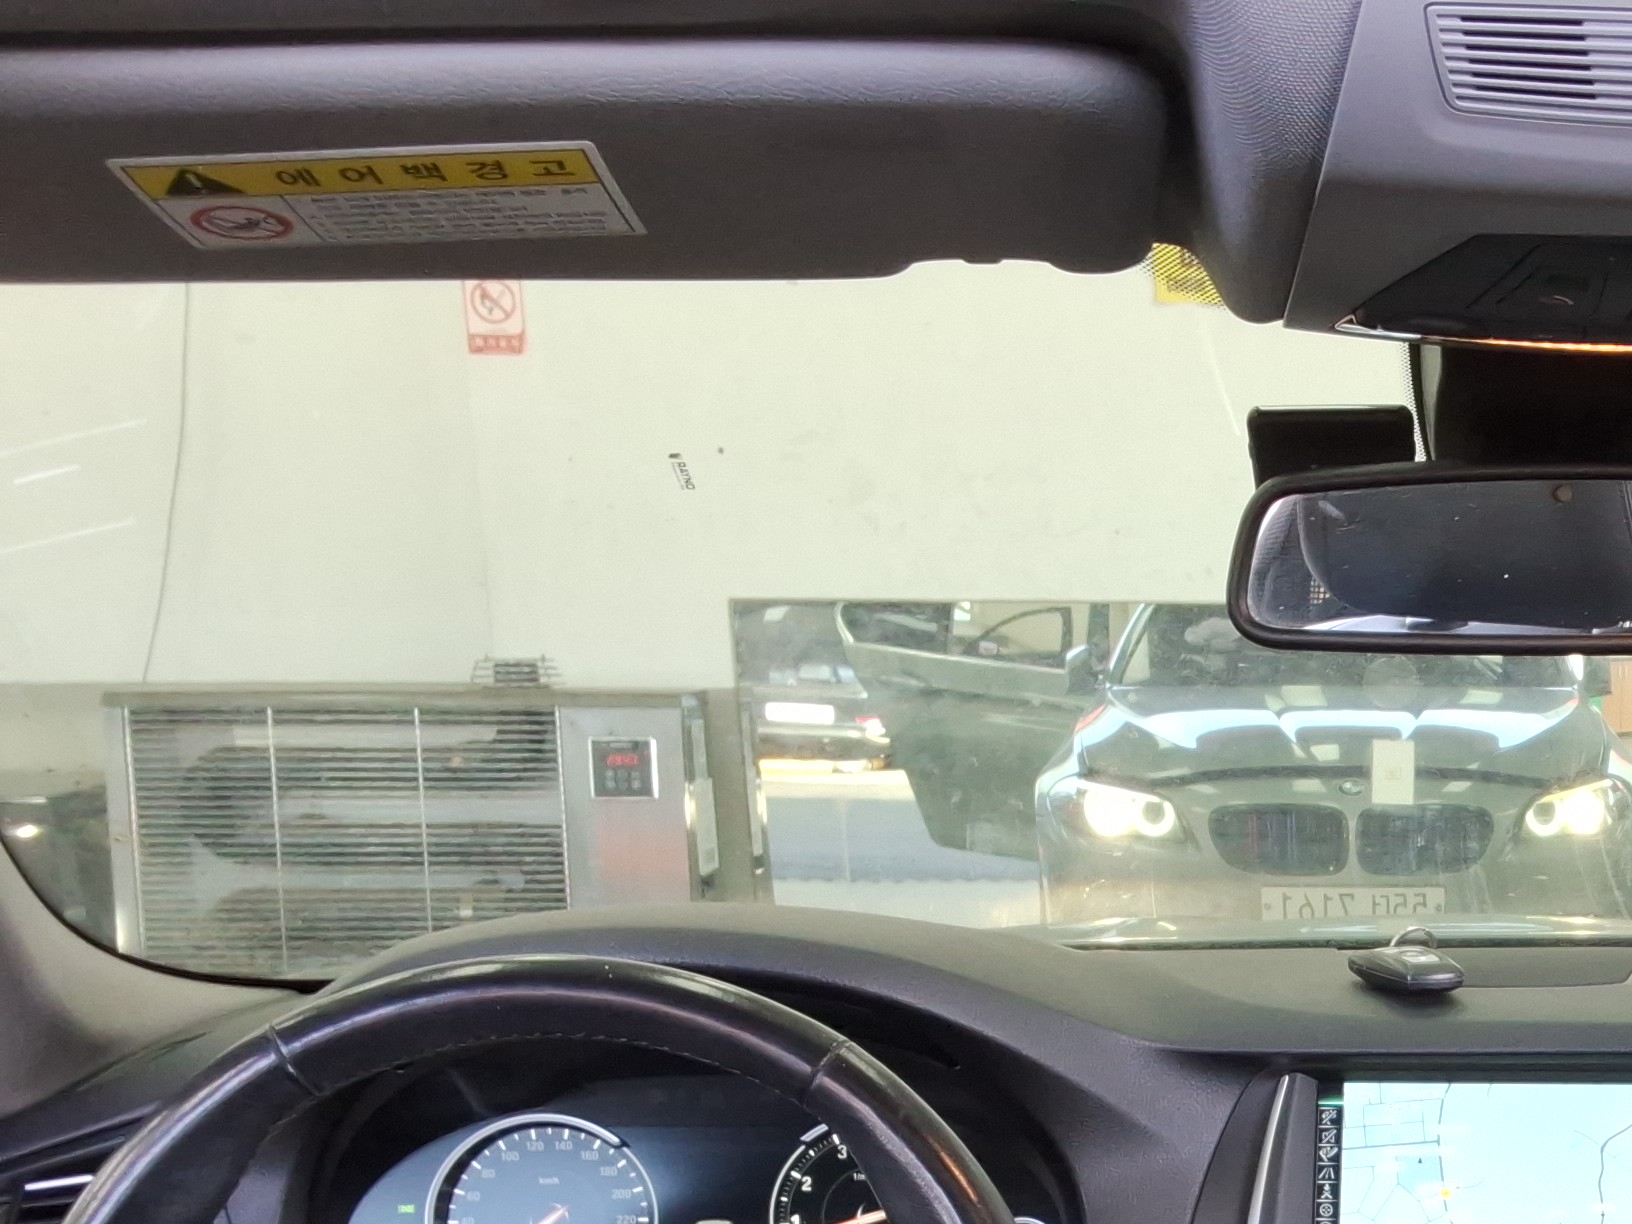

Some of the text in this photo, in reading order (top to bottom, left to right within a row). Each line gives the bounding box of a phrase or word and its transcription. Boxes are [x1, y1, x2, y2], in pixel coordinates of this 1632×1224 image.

[676, 461, 696, 491] RAYNO
[837, 1144, 848, 1160] 3
[801, 1176, 813, 1192] 2
